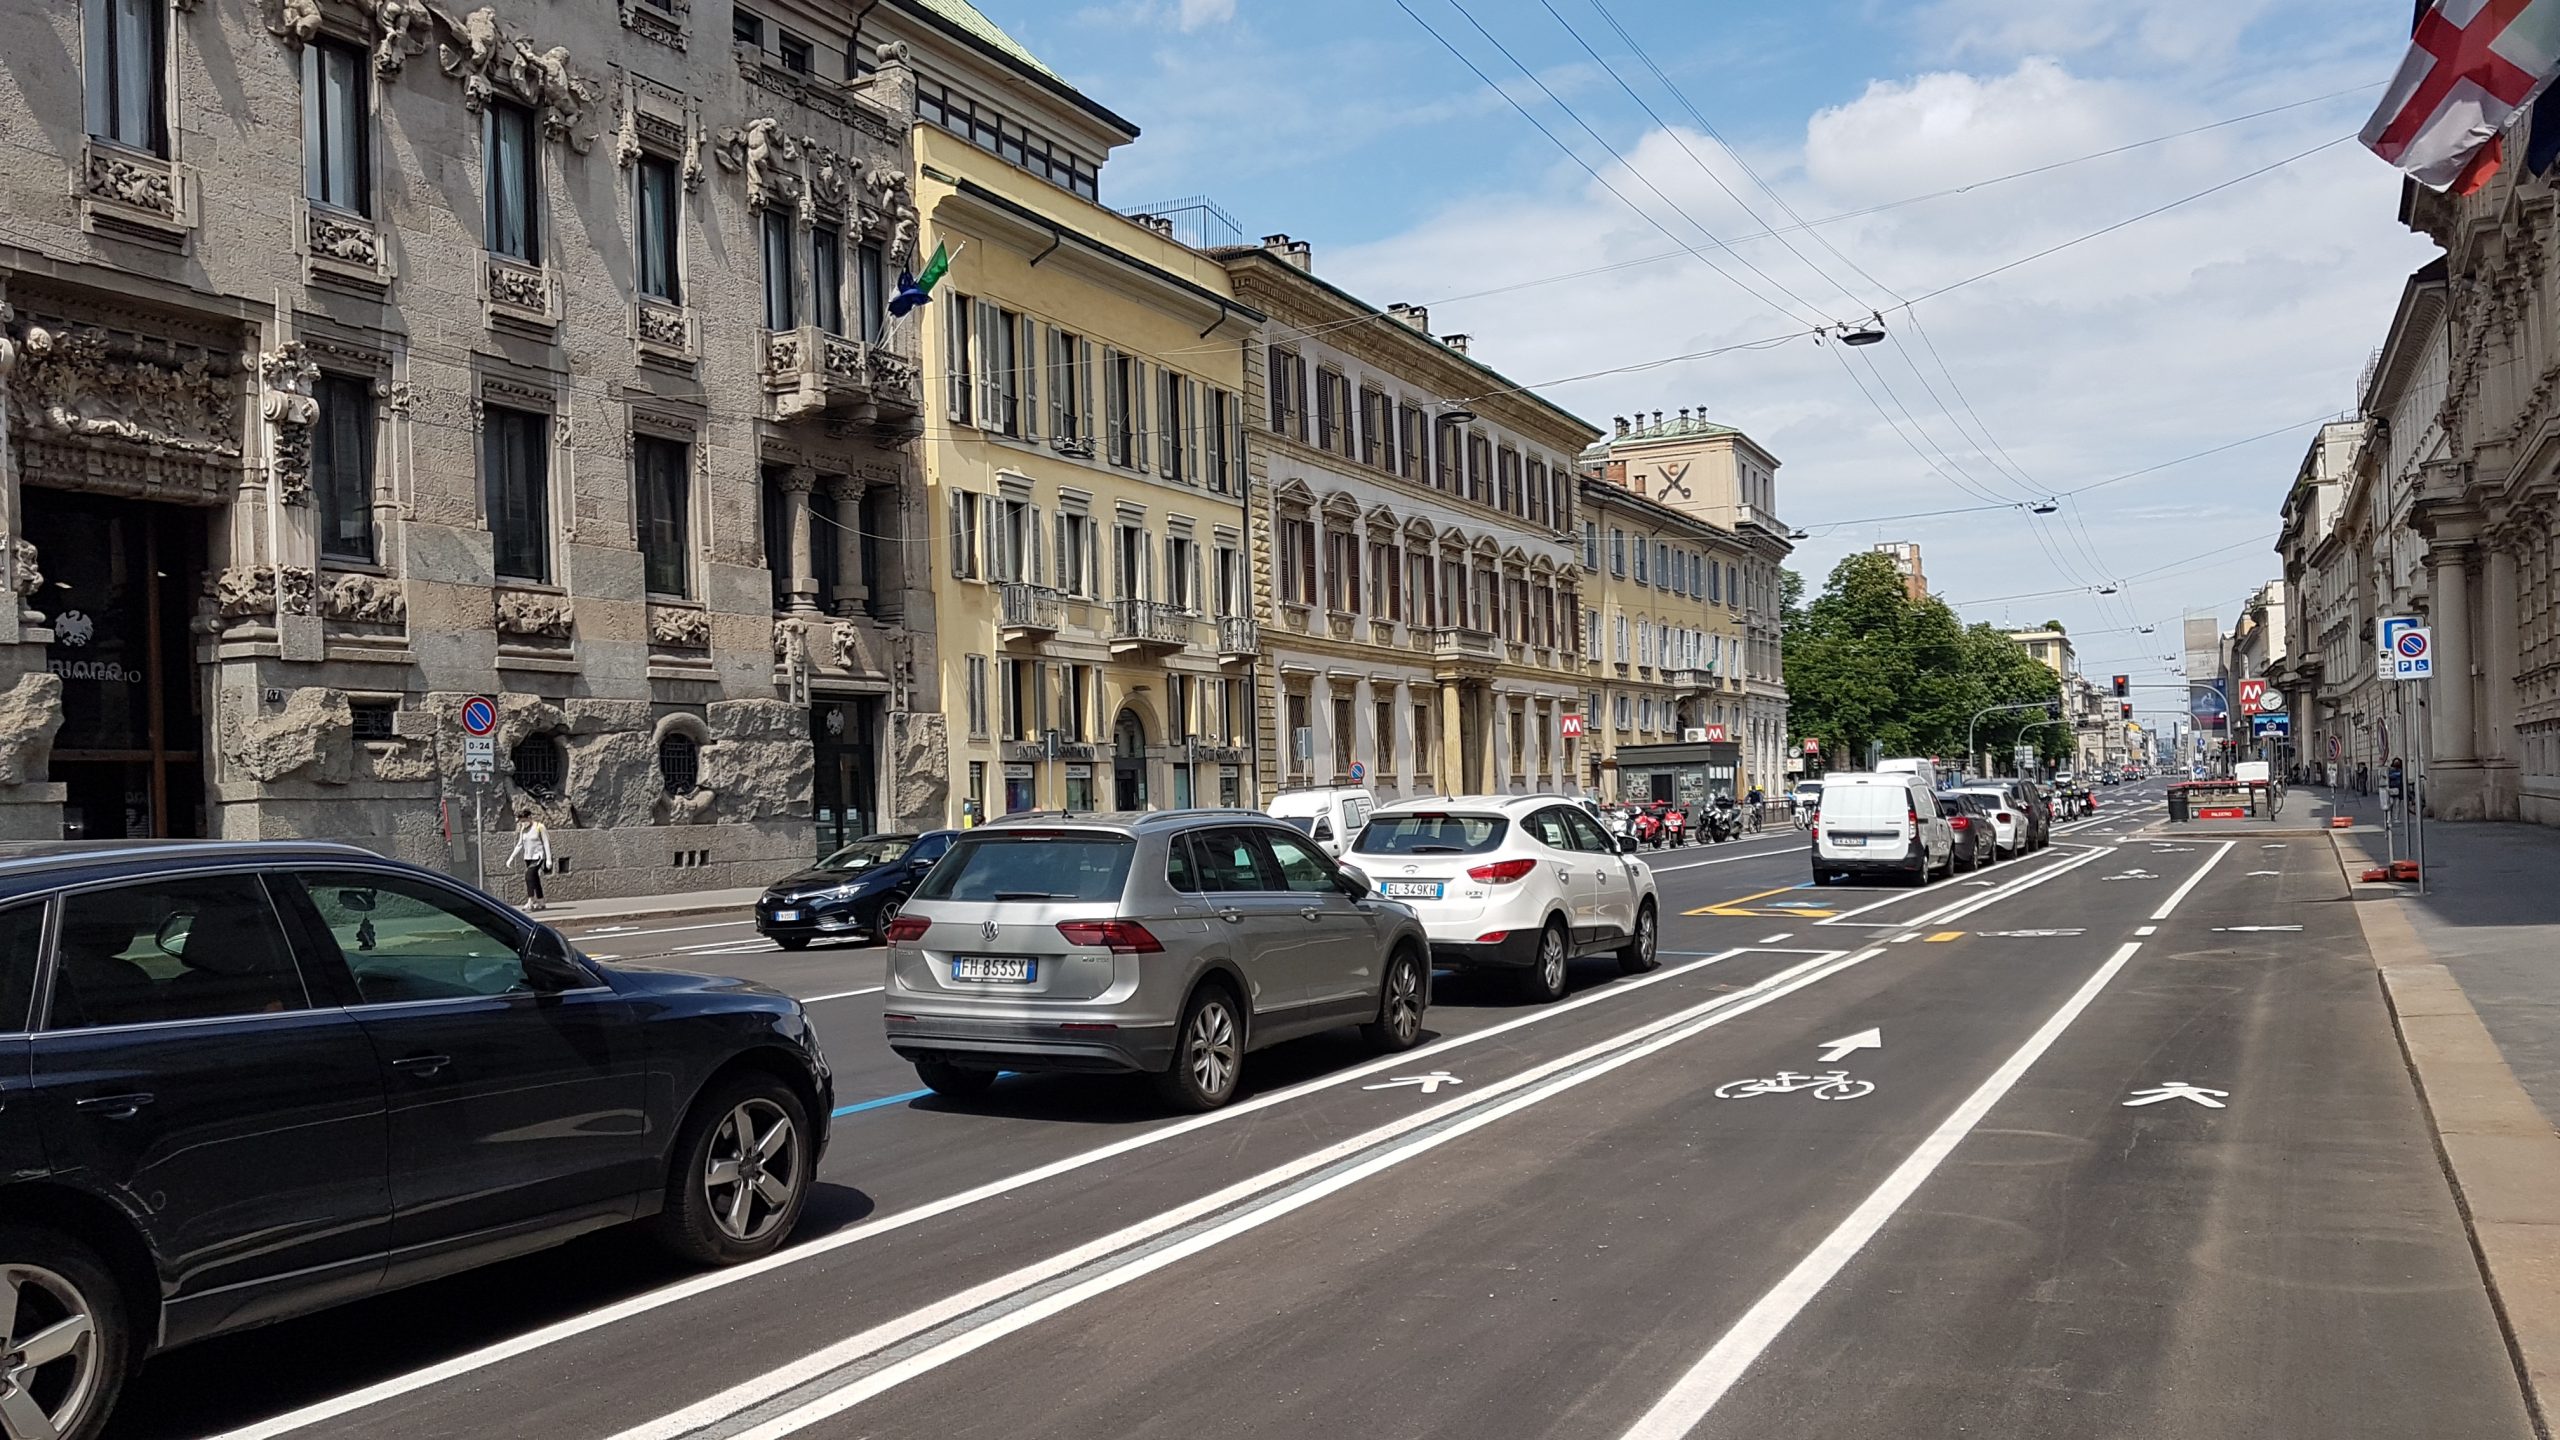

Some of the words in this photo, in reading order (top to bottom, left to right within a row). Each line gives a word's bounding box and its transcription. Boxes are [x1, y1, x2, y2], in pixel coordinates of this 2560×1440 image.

[2401, 662, 2409, 671] P
[269, 690, 280, 700] 47
[1562, 719, 1581, 733] M
[1708, 728, 1723, 740] M
[469, 742, 474, 750] 0
[479, 742, 490, 750] 24
[1387, 883, 1400, 895] EL
[1404, 884, 1436, 896] 349KH
[961, 958, 978, 976] FH
[982, 959, 1026, 978] 853SX
